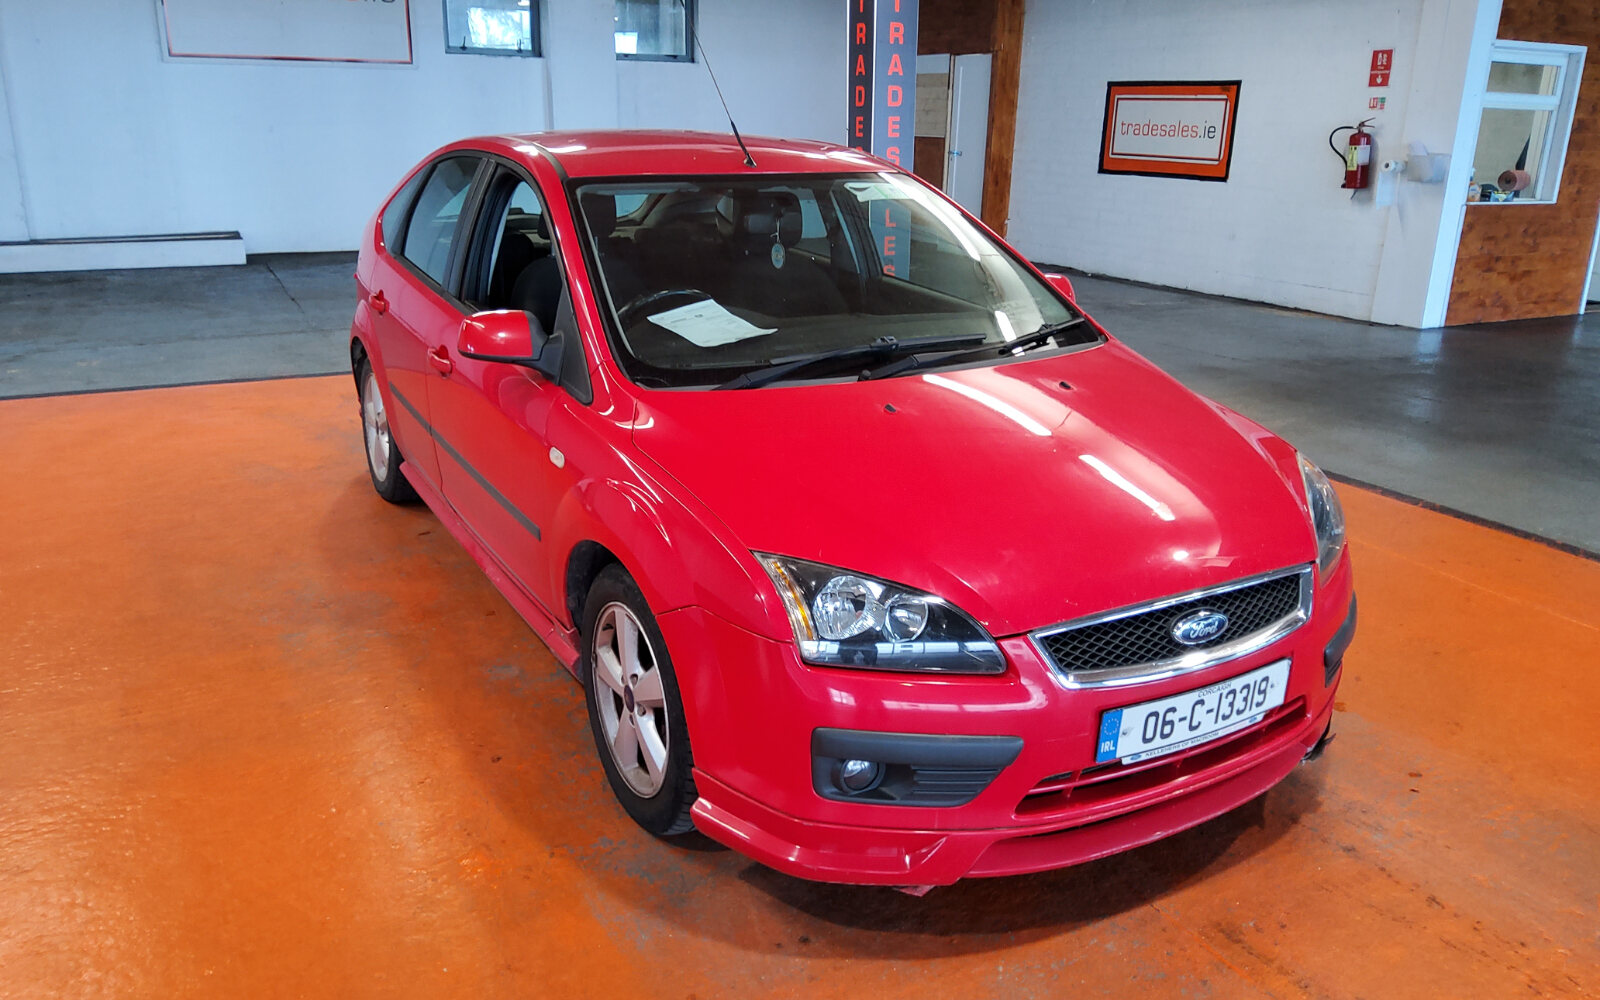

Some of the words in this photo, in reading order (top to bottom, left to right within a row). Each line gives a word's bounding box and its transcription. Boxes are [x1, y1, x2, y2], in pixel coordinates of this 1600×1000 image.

[1120, 119, 1216, 139] tradesales.ie
[1189, 617, 1218, 639] Ford
[1141, 675, 1270, 744] 06-C-13319
[1100, 742, 1116, 753] IRL
